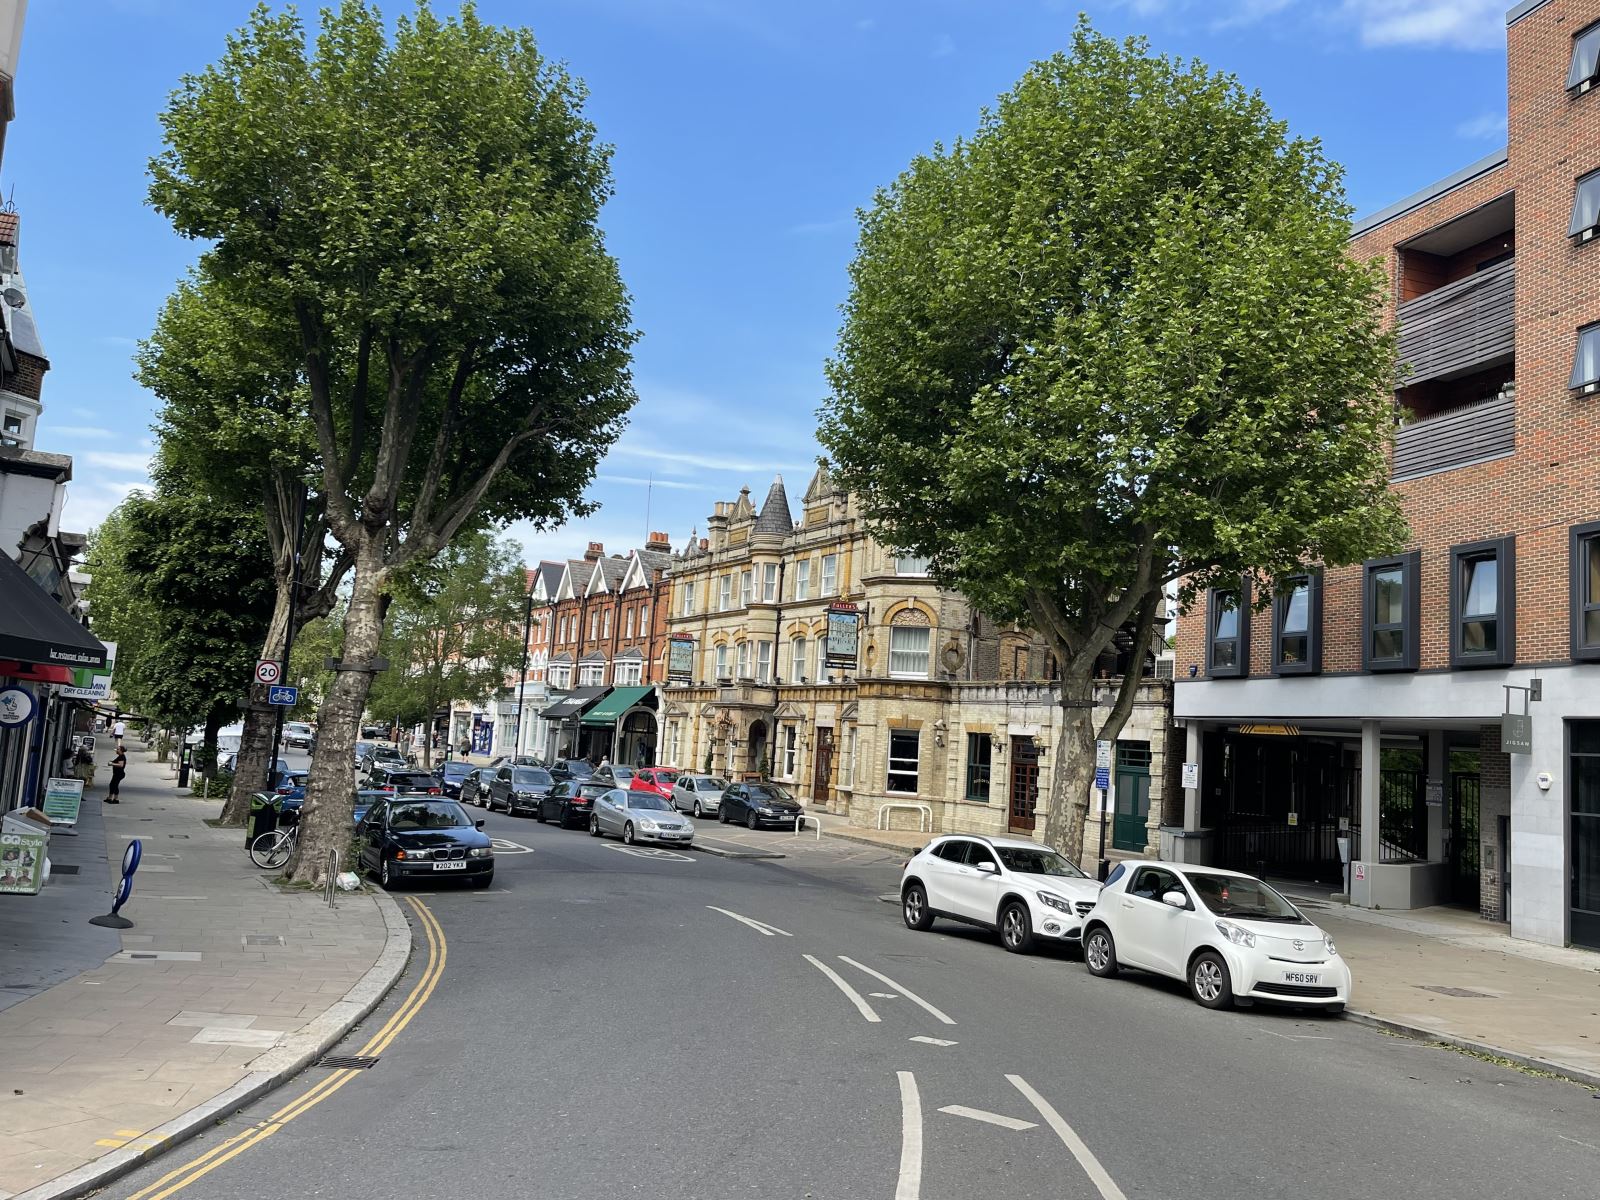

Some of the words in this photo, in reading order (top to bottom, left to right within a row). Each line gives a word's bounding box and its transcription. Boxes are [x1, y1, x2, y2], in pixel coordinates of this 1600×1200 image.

[260, 667, 276, 677] 20
[1, 835, 21, 845] GQ
[21, 839, 43, 847] Style
[1285, 972, 1304, 982] MF60
[1305, 974, 1318, 984] SRV
